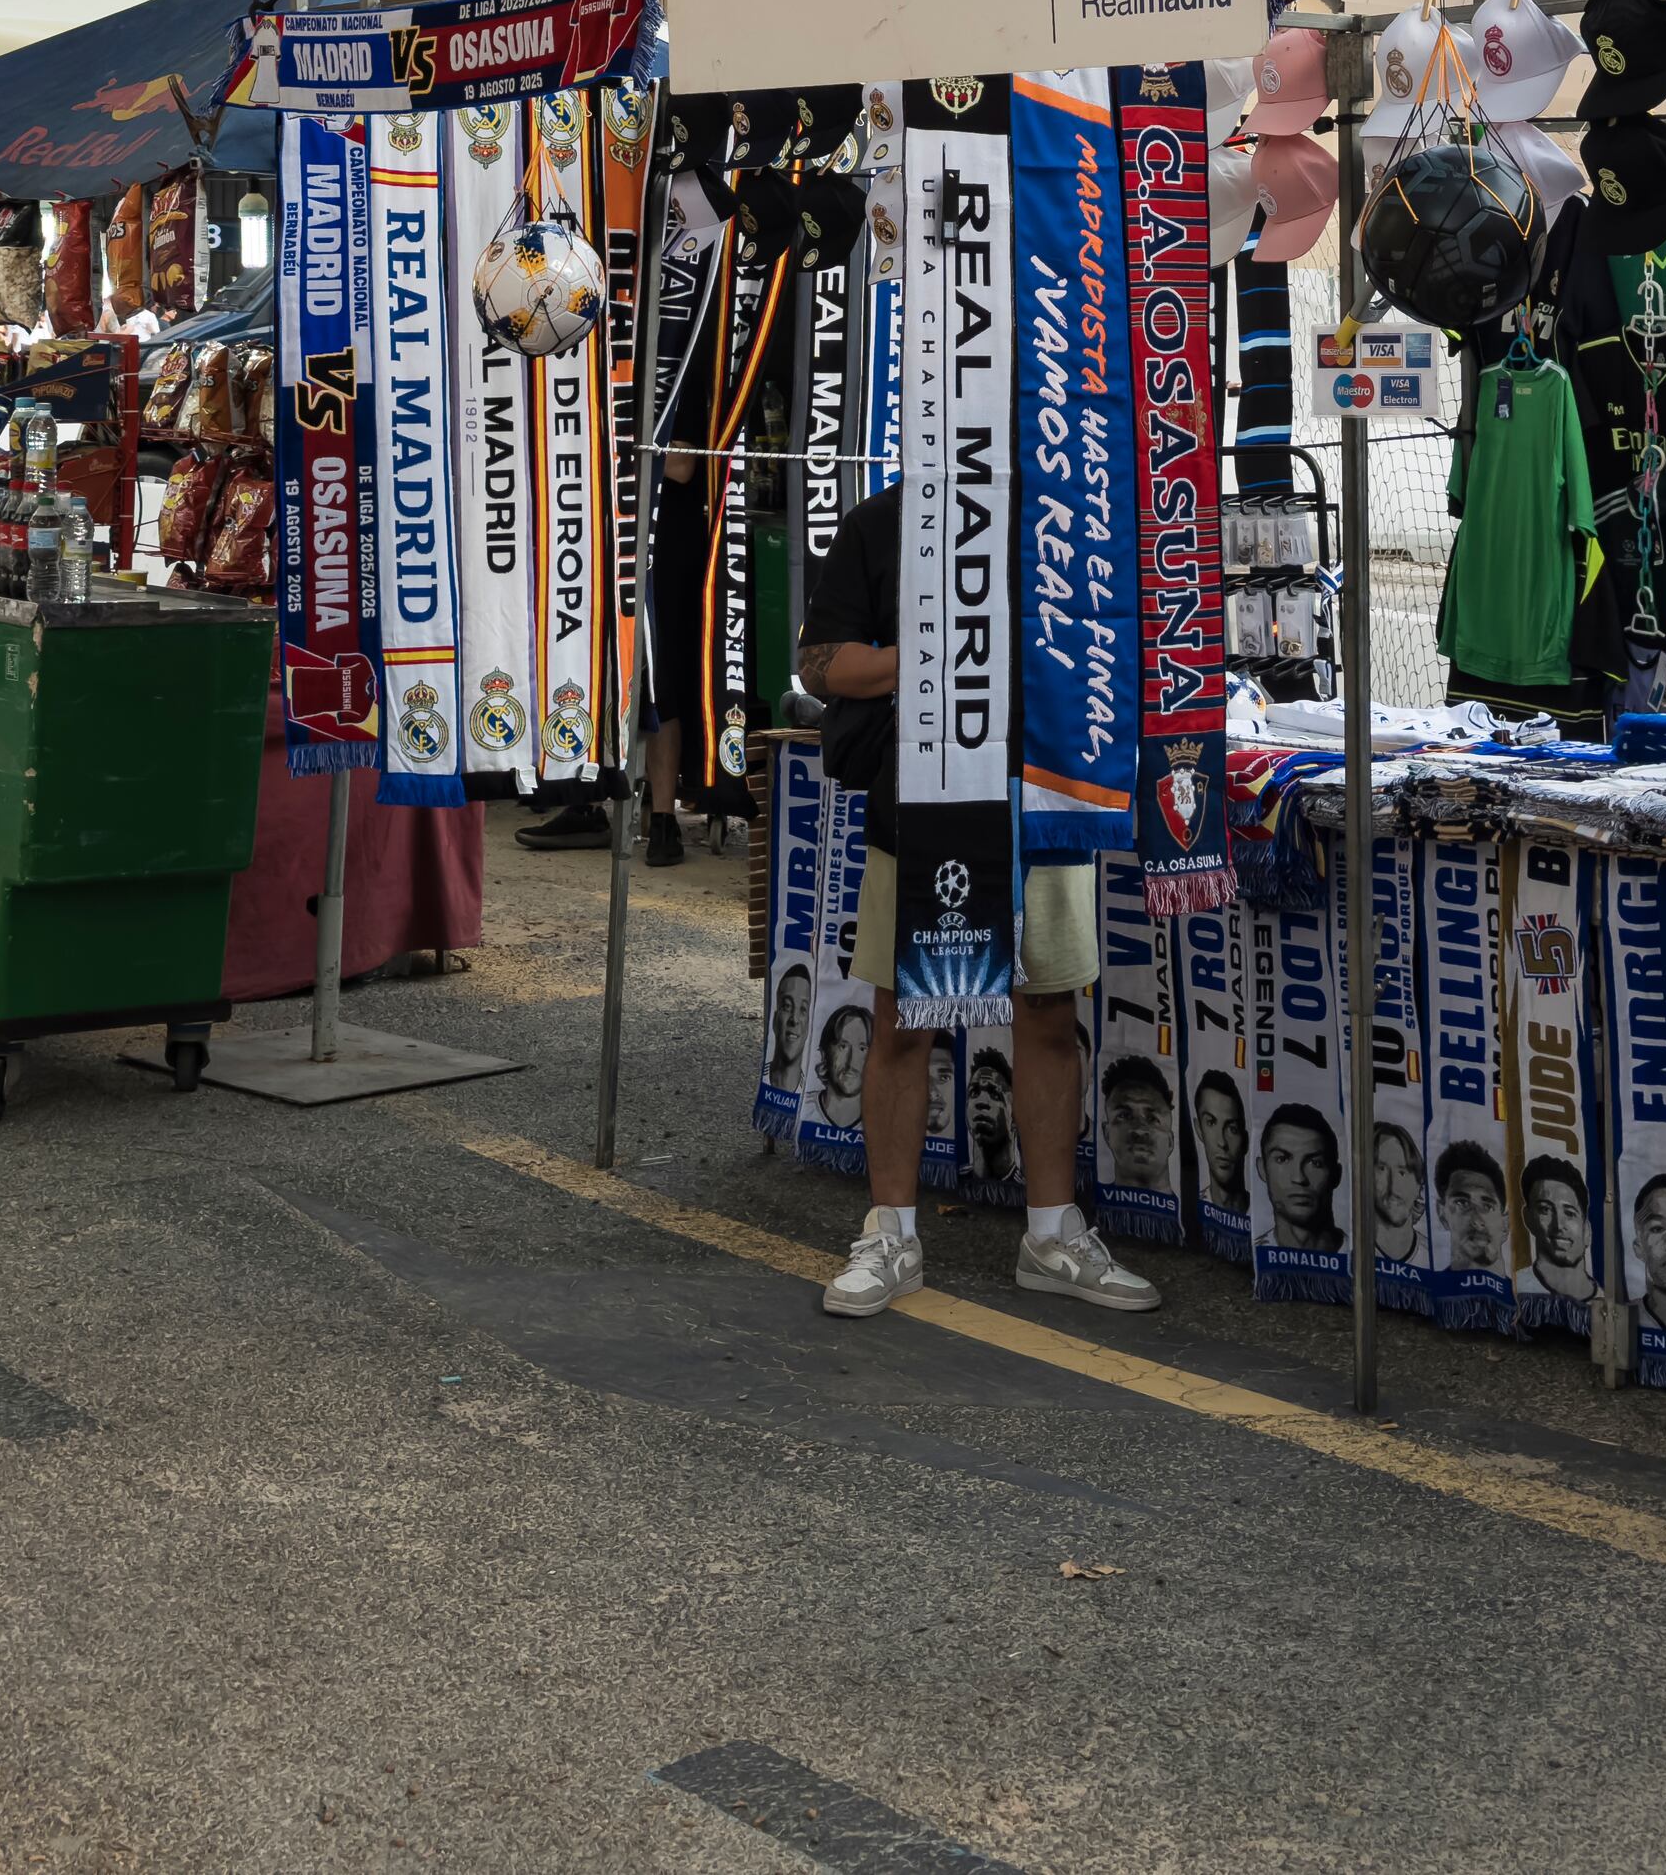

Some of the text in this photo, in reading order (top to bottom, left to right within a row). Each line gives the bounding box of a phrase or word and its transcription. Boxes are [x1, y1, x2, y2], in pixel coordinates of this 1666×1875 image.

[284, 13, 383, 32] CAMPEONATO NACIONAL
[459, 5, 472, 20] DE
[475, 1, 497, 18] LIGA
[293, 16, 556, 95] MADRID VS OSASUNA
[315, 89, 356, 109] BERNABÉU
[464, 72, 544, 101] 19 AGOSTO 2025
[67, 128, 159, 170] Bull
[283, 201, 299, 278] BERNABÉU
[349, 146, 373, 332] CAMPEONATO NACIONAL
[1075, 132, 1110, 397] MADRIDISTA
[1369, 344, 1395, 357] VISA
[295, 163, 358, 634] MADRID VS OSASUNA
[1336, 385, 1371, 396] Maestro
[1383, 395, 1418, 405] Electron
[1390, 378, 1410, 389] VISA
[387, 207, 440, 625] REAL MADRID
[465, 396, 479, 444] 1902
[1135, 123, 1203, 716] C.A. OSASUNA
[483, 395, 518, 575] MADRID
[806, 376, 843, 556] MADRID
[919, 179, 936, 755] UEFA CHAMPIONS LEAGUE
[952, 181, 993, 750] REAL MADRID
[1081, 408, 1111, 543] HASTA
[554, 377, 585, 644] DE EUROPA
[284, 478, 303, 613] 19 AGOSTO 2025
[358, 465, 377, 620] DE LIGA 2025/2026
[1033, 495, 1075, 671] REAL!
[1085, 552, 1115, 605] EL
[341, 668, 352, 712] OSASUNA
[1145, 853, 1223, 874] C.A. OSASUNA
[823, 847, 844, 946] NO LLORES
[913, 928, 992, 946] CHAMPIONS
[937, 913, 967, 929] UEFA
[931, 945, 975, 957] LEAGUE
[1515, 925, 1577, 979] 5
[1107, 995, 1156, 1025] 7
[1195, 998, 1230, 1032] 7
[1282, 1034, 1328, 1070] 7
[764, 1089, 798, 1109] KYLIAN
[1527, 1021, 1580, 1156] JUDE
[814, 1126, 865, 1145] LUKA
[1101, 1187, 1177, 1212] VINICIUS
[1267, 1249, 1341, 1271] RONALDO
[1459, 1273, 1505, 1295] JUDE
